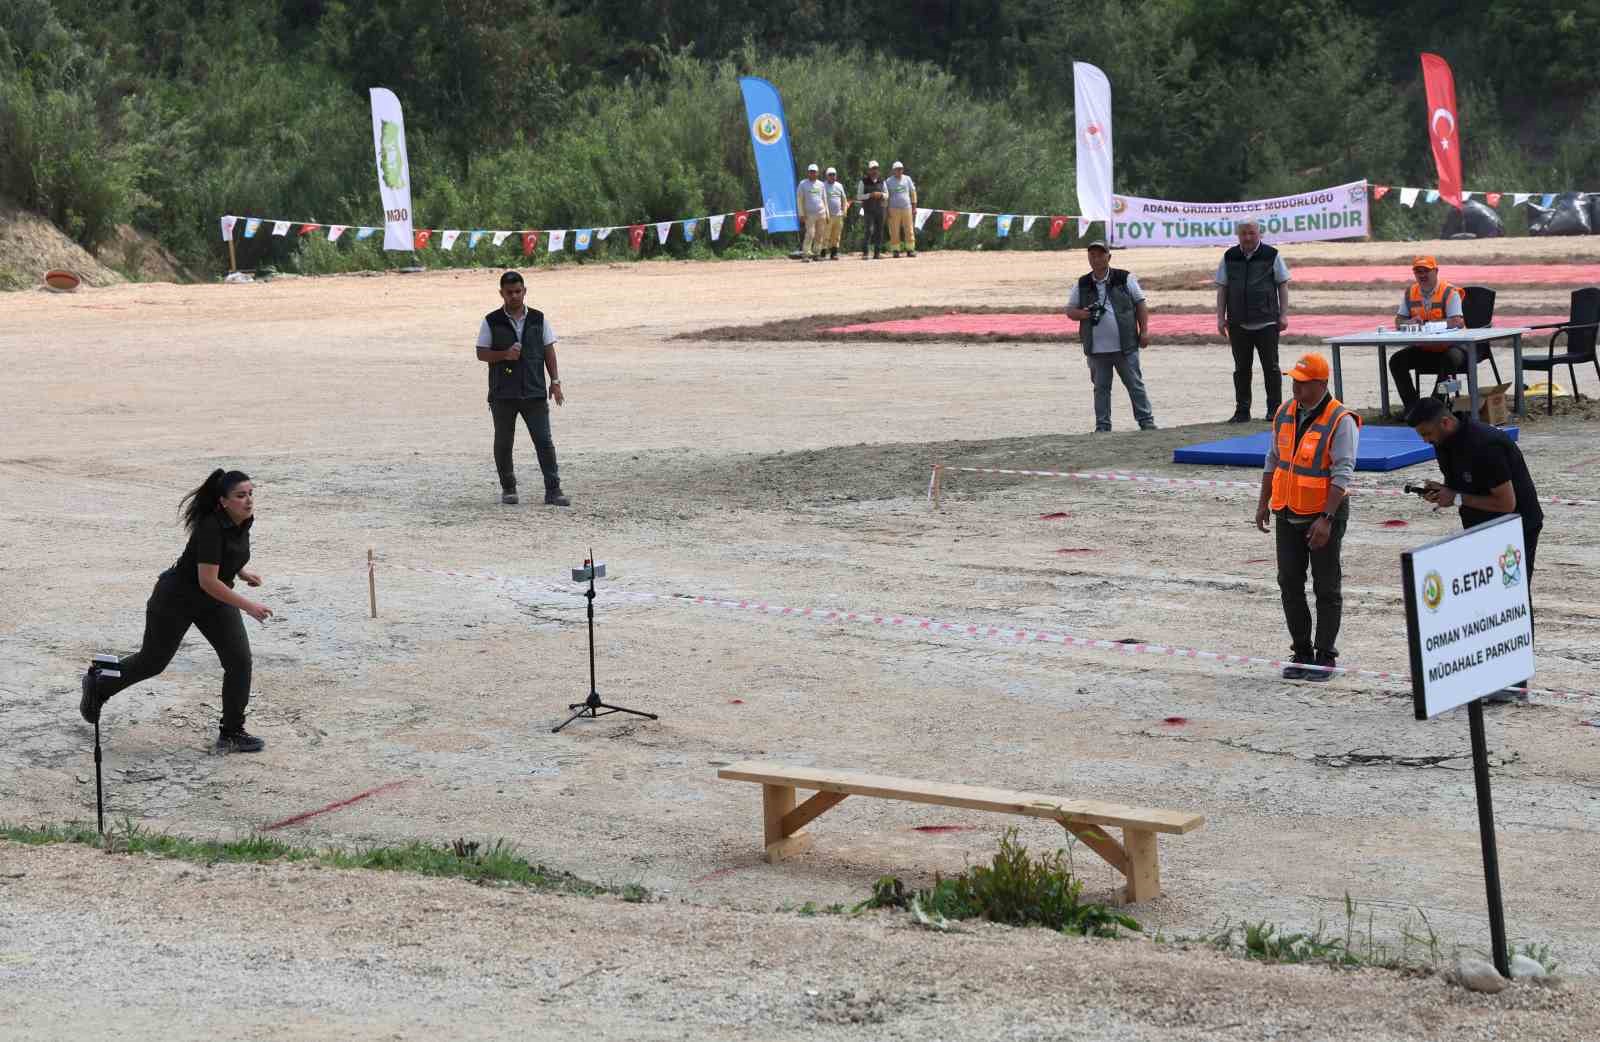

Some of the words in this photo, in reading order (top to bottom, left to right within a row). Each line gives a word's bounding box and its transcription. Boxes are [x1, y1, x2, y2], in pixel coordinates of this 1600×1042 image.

[1143, 203, 1179, 213] ADANA
[1182, 204, 1222, 214] ORMAN
[1115, 221, 1155, 239] TOY
[1451, 566, 1494, 596] 6.ETAP
[1426, 628, 1460, 652] ORMAN
[1462, 603, 1527, 638] YANGINLARINA
[1428, 650, 1484, 682] MÜDAHALE
[1485, 632, 1530, 661] PARKURU
